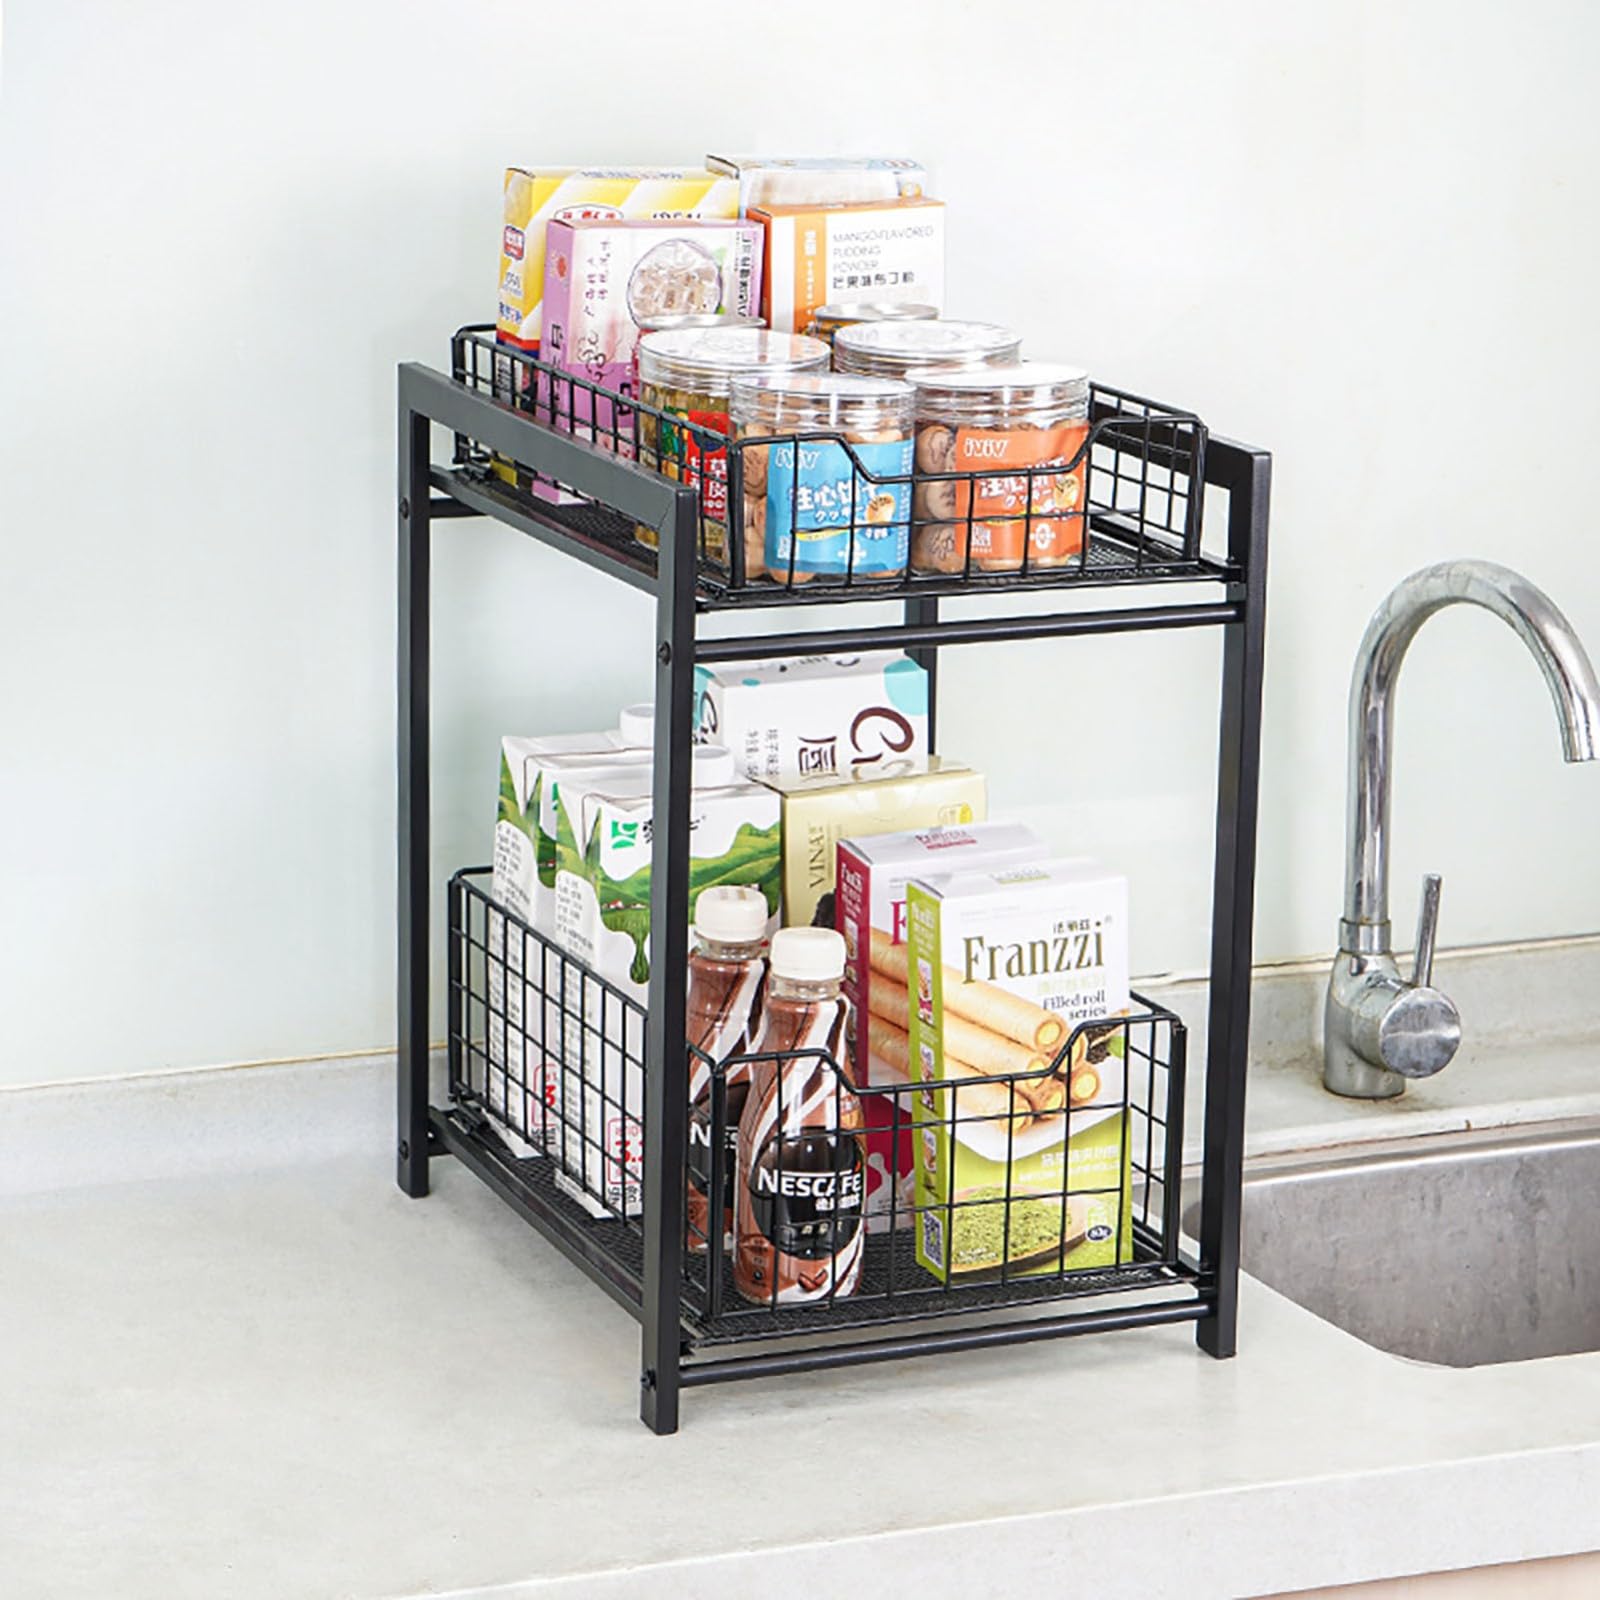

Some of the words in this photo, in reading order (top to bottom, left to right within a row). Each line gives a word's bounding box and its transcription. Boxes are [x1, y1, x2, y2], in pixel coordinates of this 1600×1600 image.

[833, 245, 881, 258] PUDDING
[833, 260, 879, 273] POWDER
[962, 920, 1105, 985] Franzzi
[1043, 993, 1081, 1011] Filled
[1082, 990, 1105, 1004] roll
[1069, 1005, 1107, 1020] series
